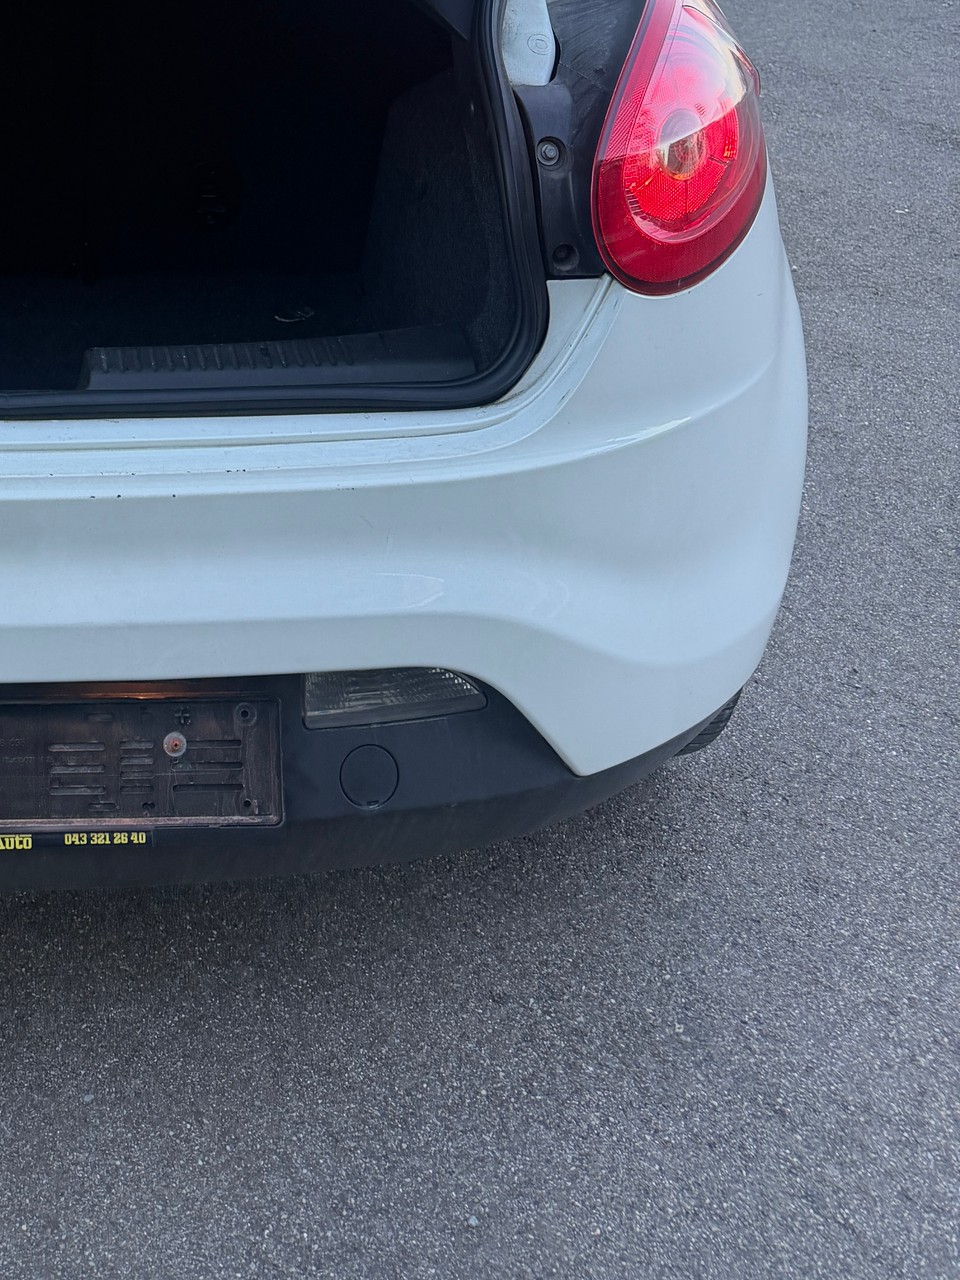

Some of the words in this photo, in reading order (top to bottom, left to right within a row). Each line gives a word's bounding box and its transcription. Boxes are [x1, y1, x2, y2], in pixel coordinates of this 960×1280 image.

[64, 833, 88, 846] 043
[90, 832, 111, 845] 321
[113, 832, 129, 845] 26
[130, 832, 147, 844] 40
